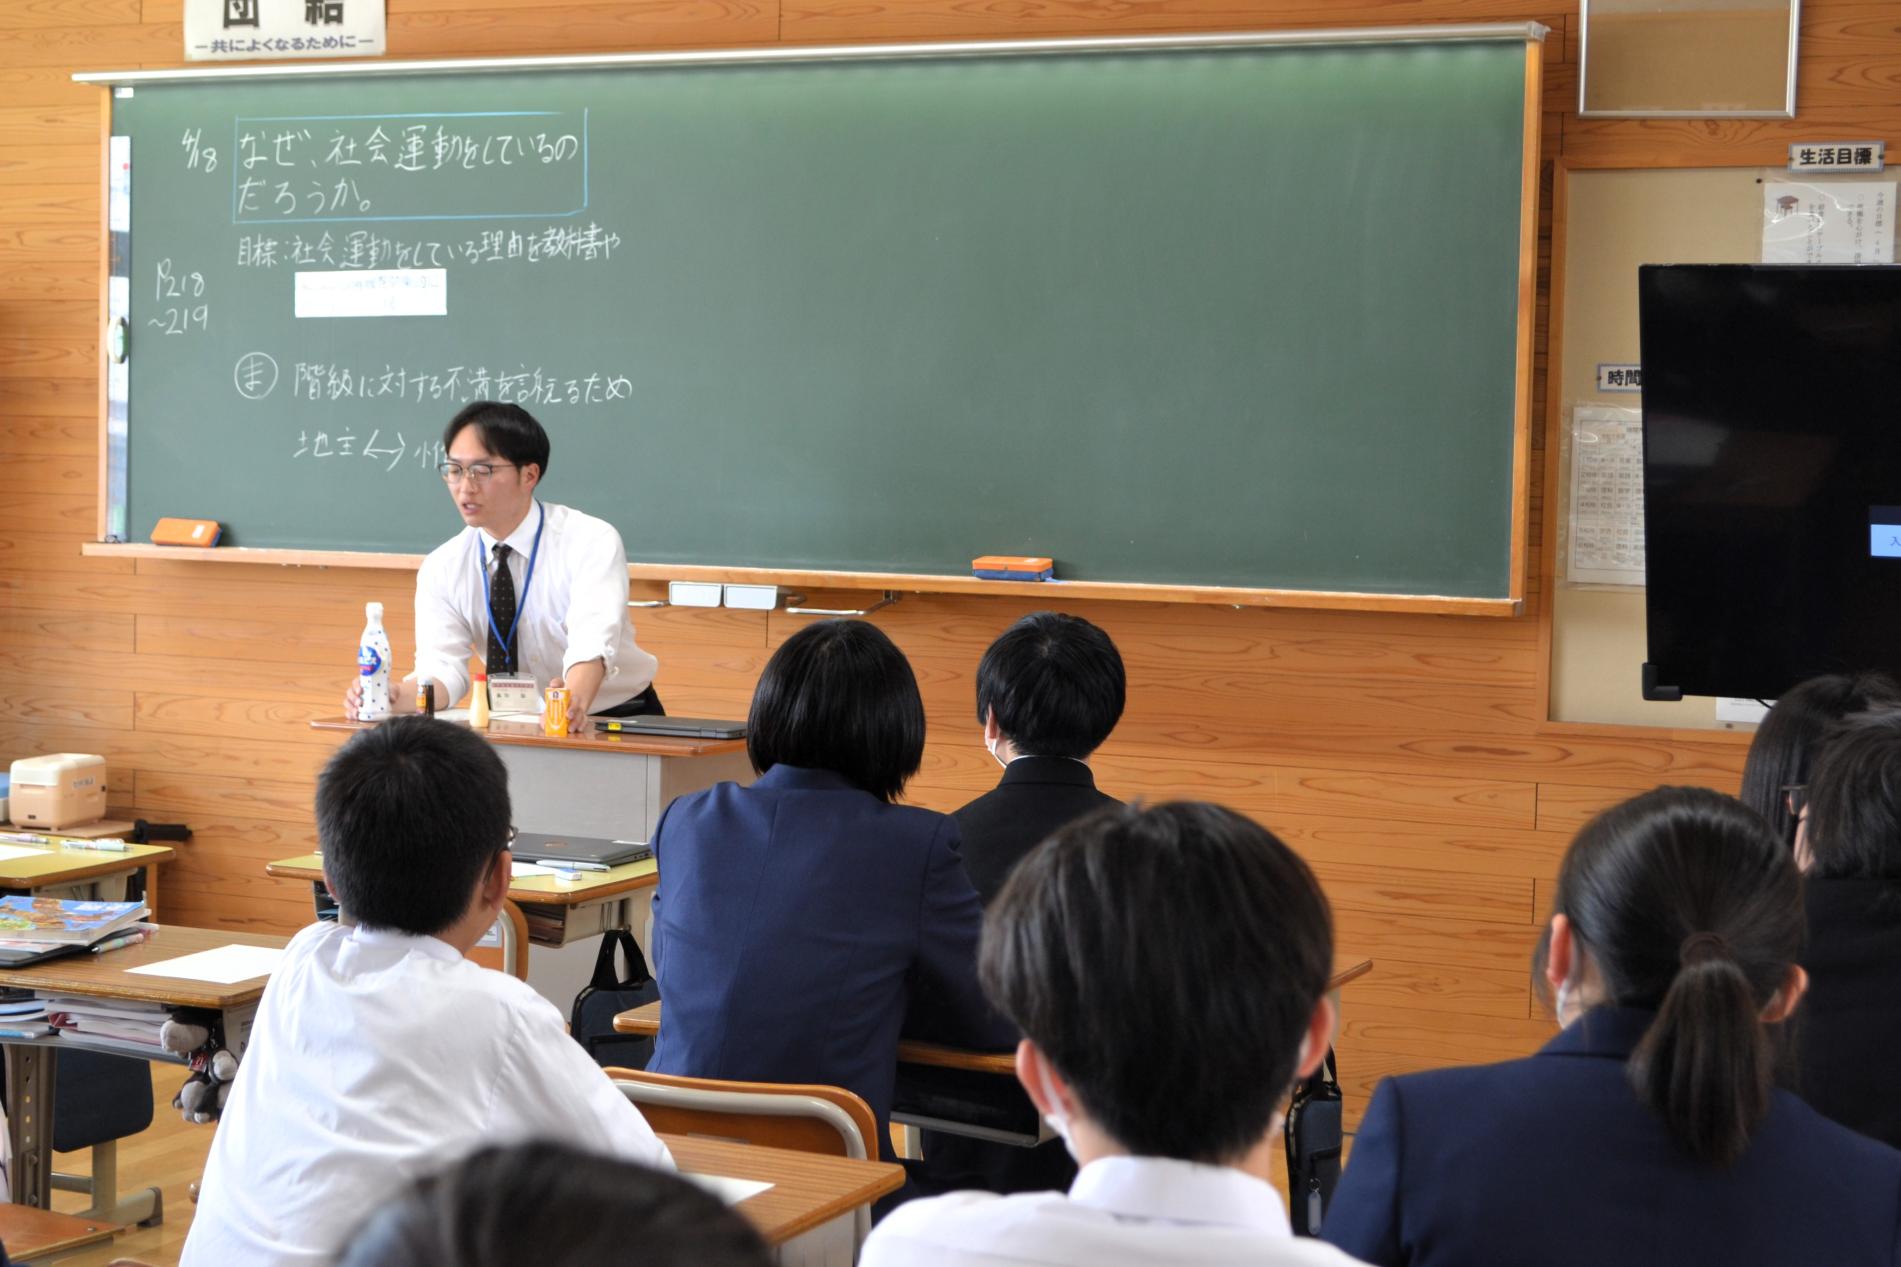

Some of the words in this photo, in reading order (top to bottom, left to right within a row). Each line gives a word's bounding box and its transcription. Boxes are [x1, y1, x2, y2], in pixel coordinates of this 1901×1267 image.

[1799, 147, 1872, 165] 生活目標
[238, 176, 371, 215] だろうか。
